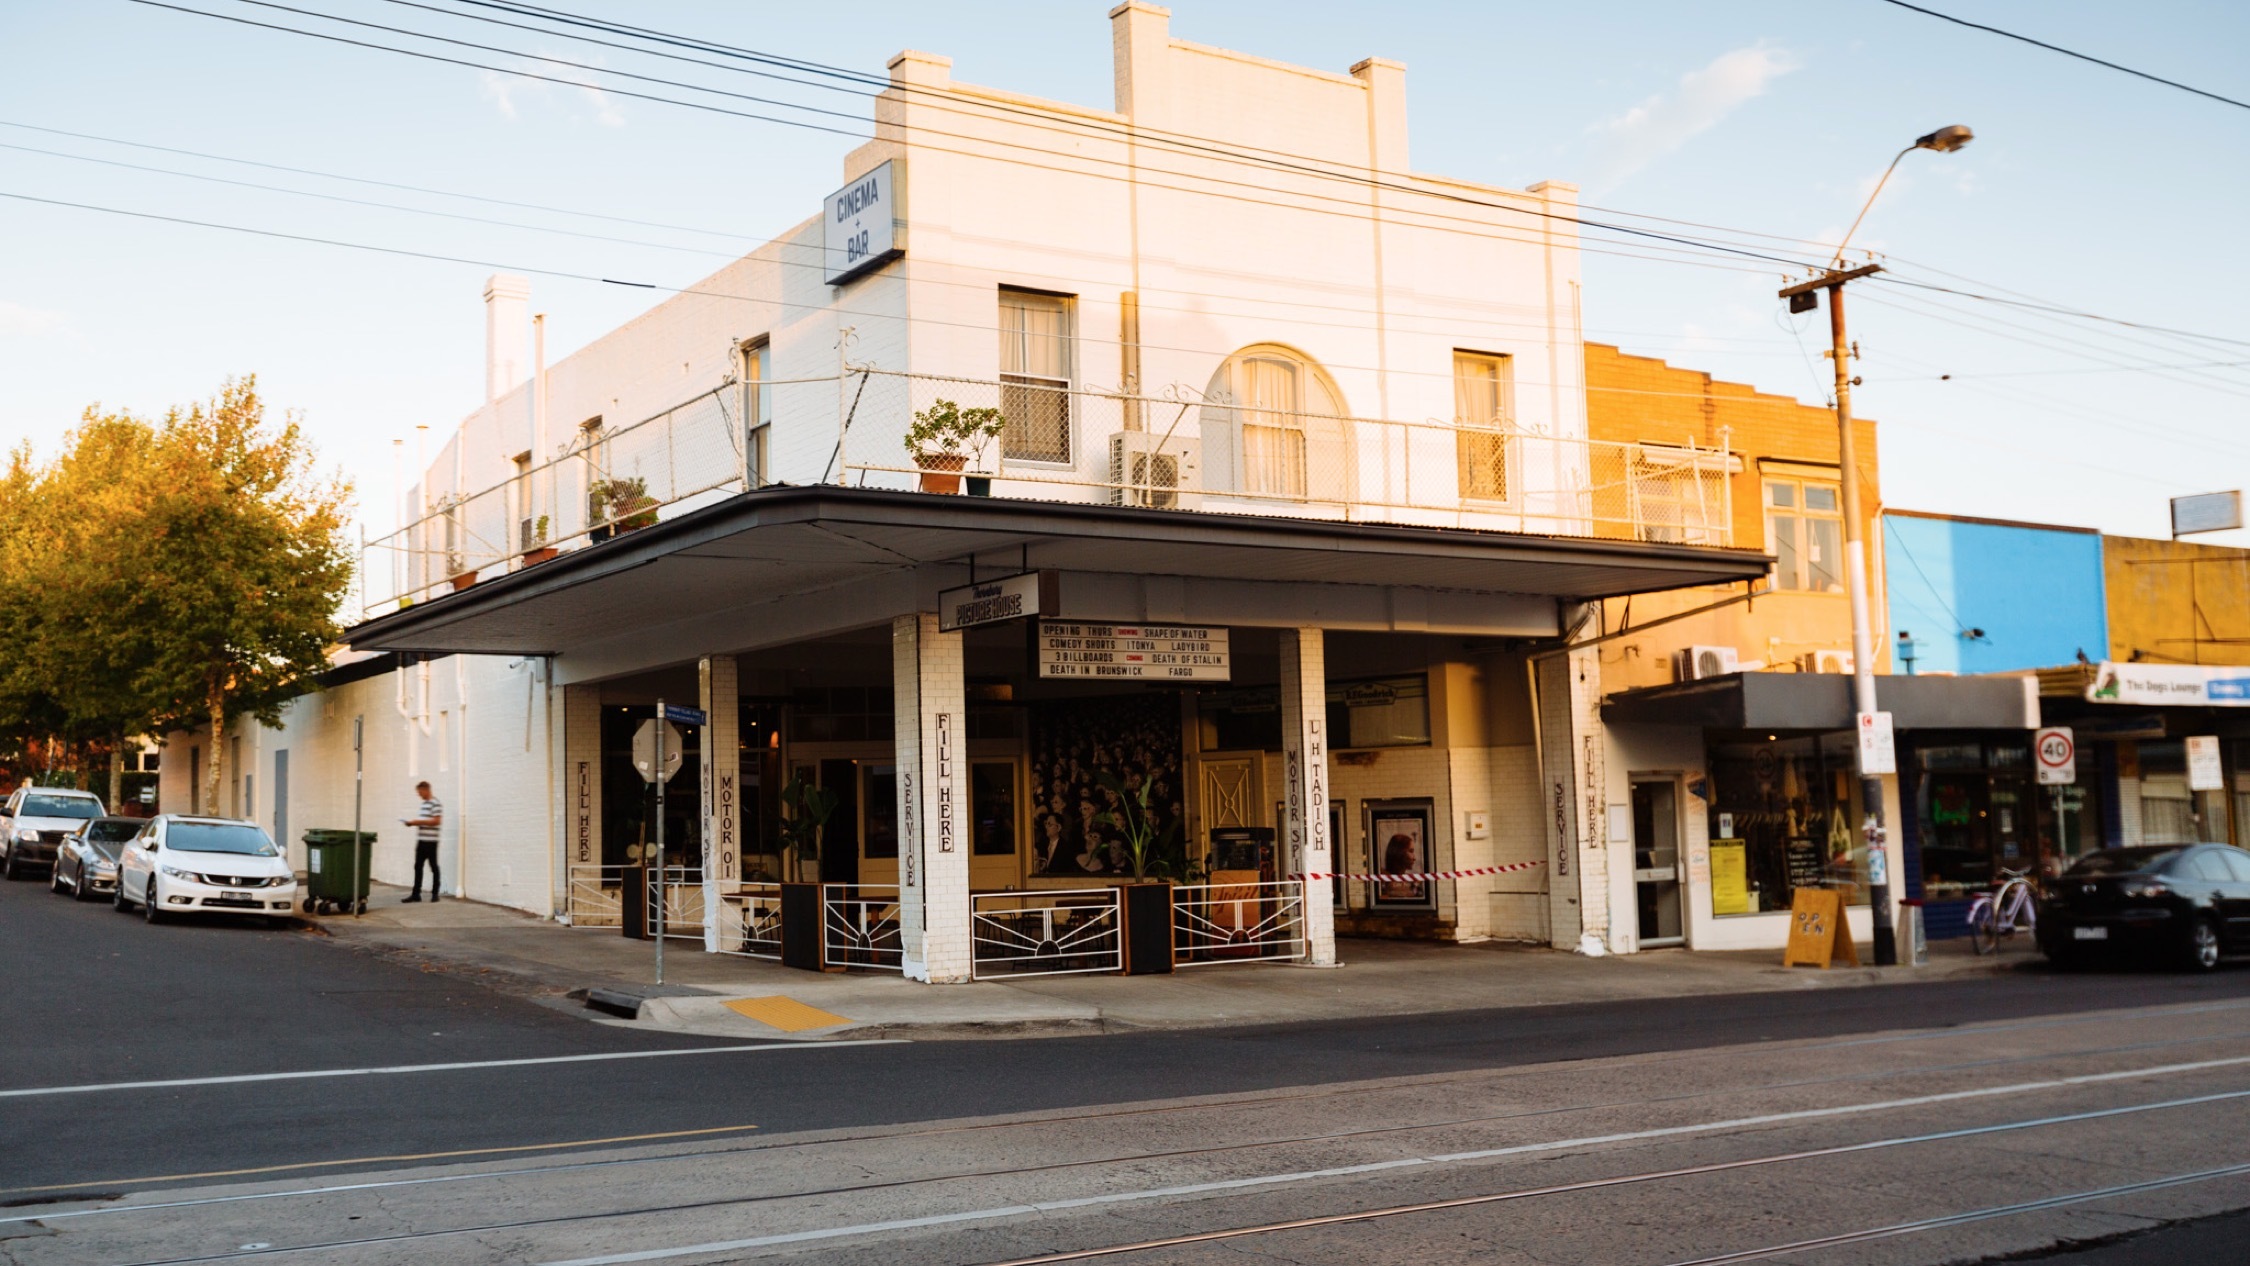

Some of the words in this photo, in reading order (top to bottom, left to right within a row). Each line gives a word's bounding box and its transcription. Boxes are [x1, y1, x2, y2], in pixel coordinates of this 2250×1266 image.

[837, 178, 879, 223] CINEMA
[848, 229, 869, 263] BAR
[1044, 625, 1081, 636] OPENING
[1088, 626, 1113, 637] THURS
[1144, 628, 1169, 639] SHAPE
[1170, 629, 1180, 639] OF
[1181, 629, 1208, 640] WATER
[1049, 639, 1082, 649] COMEDY
[1086, 639, 1116, 650] SHORTS
[1171, 642, 1211, 652] LADYBIRD
[1050, 664, 1076, 675] DEATH
[1081, 665, 1090, 675] IN
[1096, 666, 1143, 676] BRUNSWICK
[1169, 667, 1193, 677] FARGO
[1056, 651, 1061, 662] 3
[1062, 652, 1114, 663] BILLBOARDS
[1152, 654, 1177, 664] DEATH
[1181, 655, 1191, 665] OF
[1193, 655, 1222, 665] STALIN
[938, 715, 949, 778] FILL
[1584, 736, 1594, 788] FILL
[2044, 741, 2066, 758] 40
[580, 763, 589, 809] FILL
[722, 777, 732, 844] MOTOR
[1288, 751, 1299, 822] MOTOR
[1312, 764, 1324, 850] TADICH
[580, 815, 589, 862] HERE
[904, 773, 914, 887] SERVICE
[940, 787, 952, 851] HERE
[1556, 783, 1567, 876] SERVICE
[1588, 796, 1597, 849] HERE
